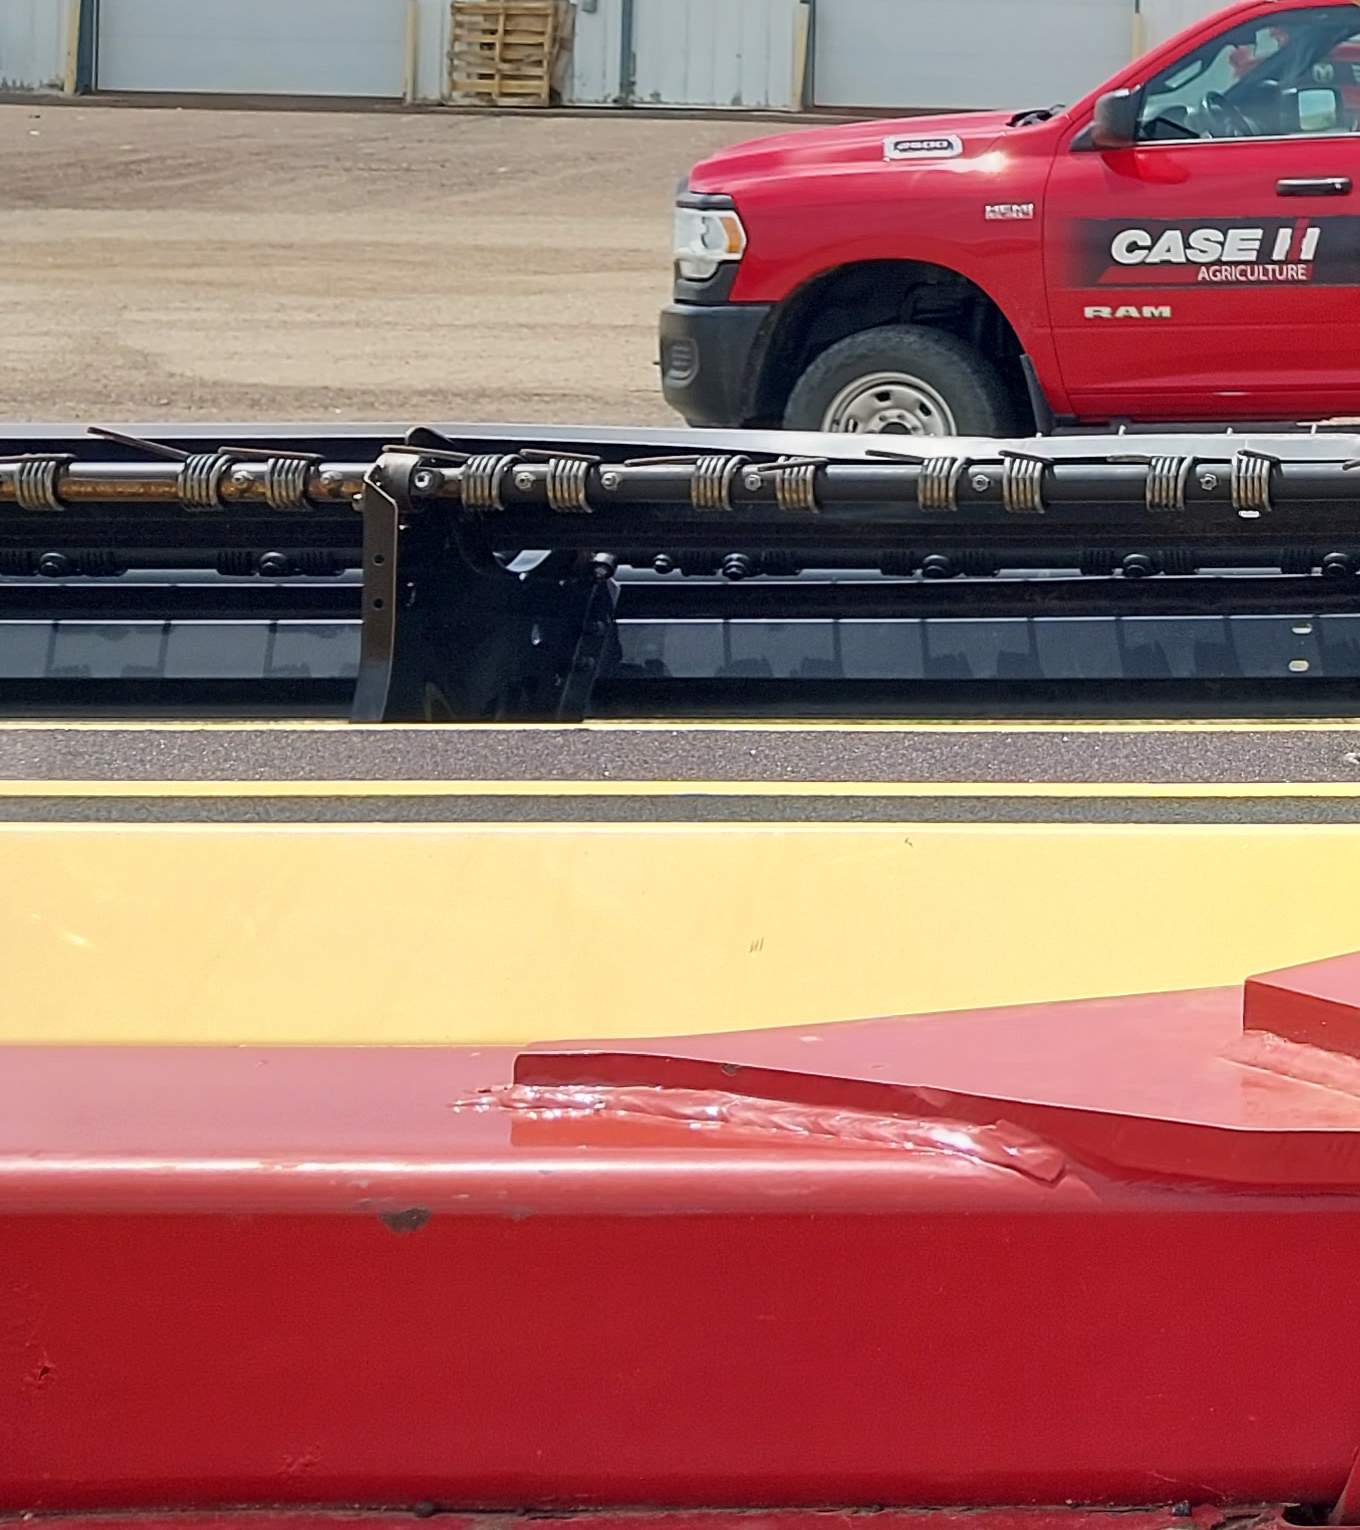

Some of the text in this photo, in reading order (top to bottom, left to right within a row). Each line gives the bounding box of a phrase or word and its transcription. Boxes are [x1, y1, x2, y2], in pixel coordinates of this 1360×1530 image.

[1111, 228, 1263, 265] CASE
[1197, 264, 1308, 282] AGRICULTURE
[1083, 305, 1172, 320] RAM
